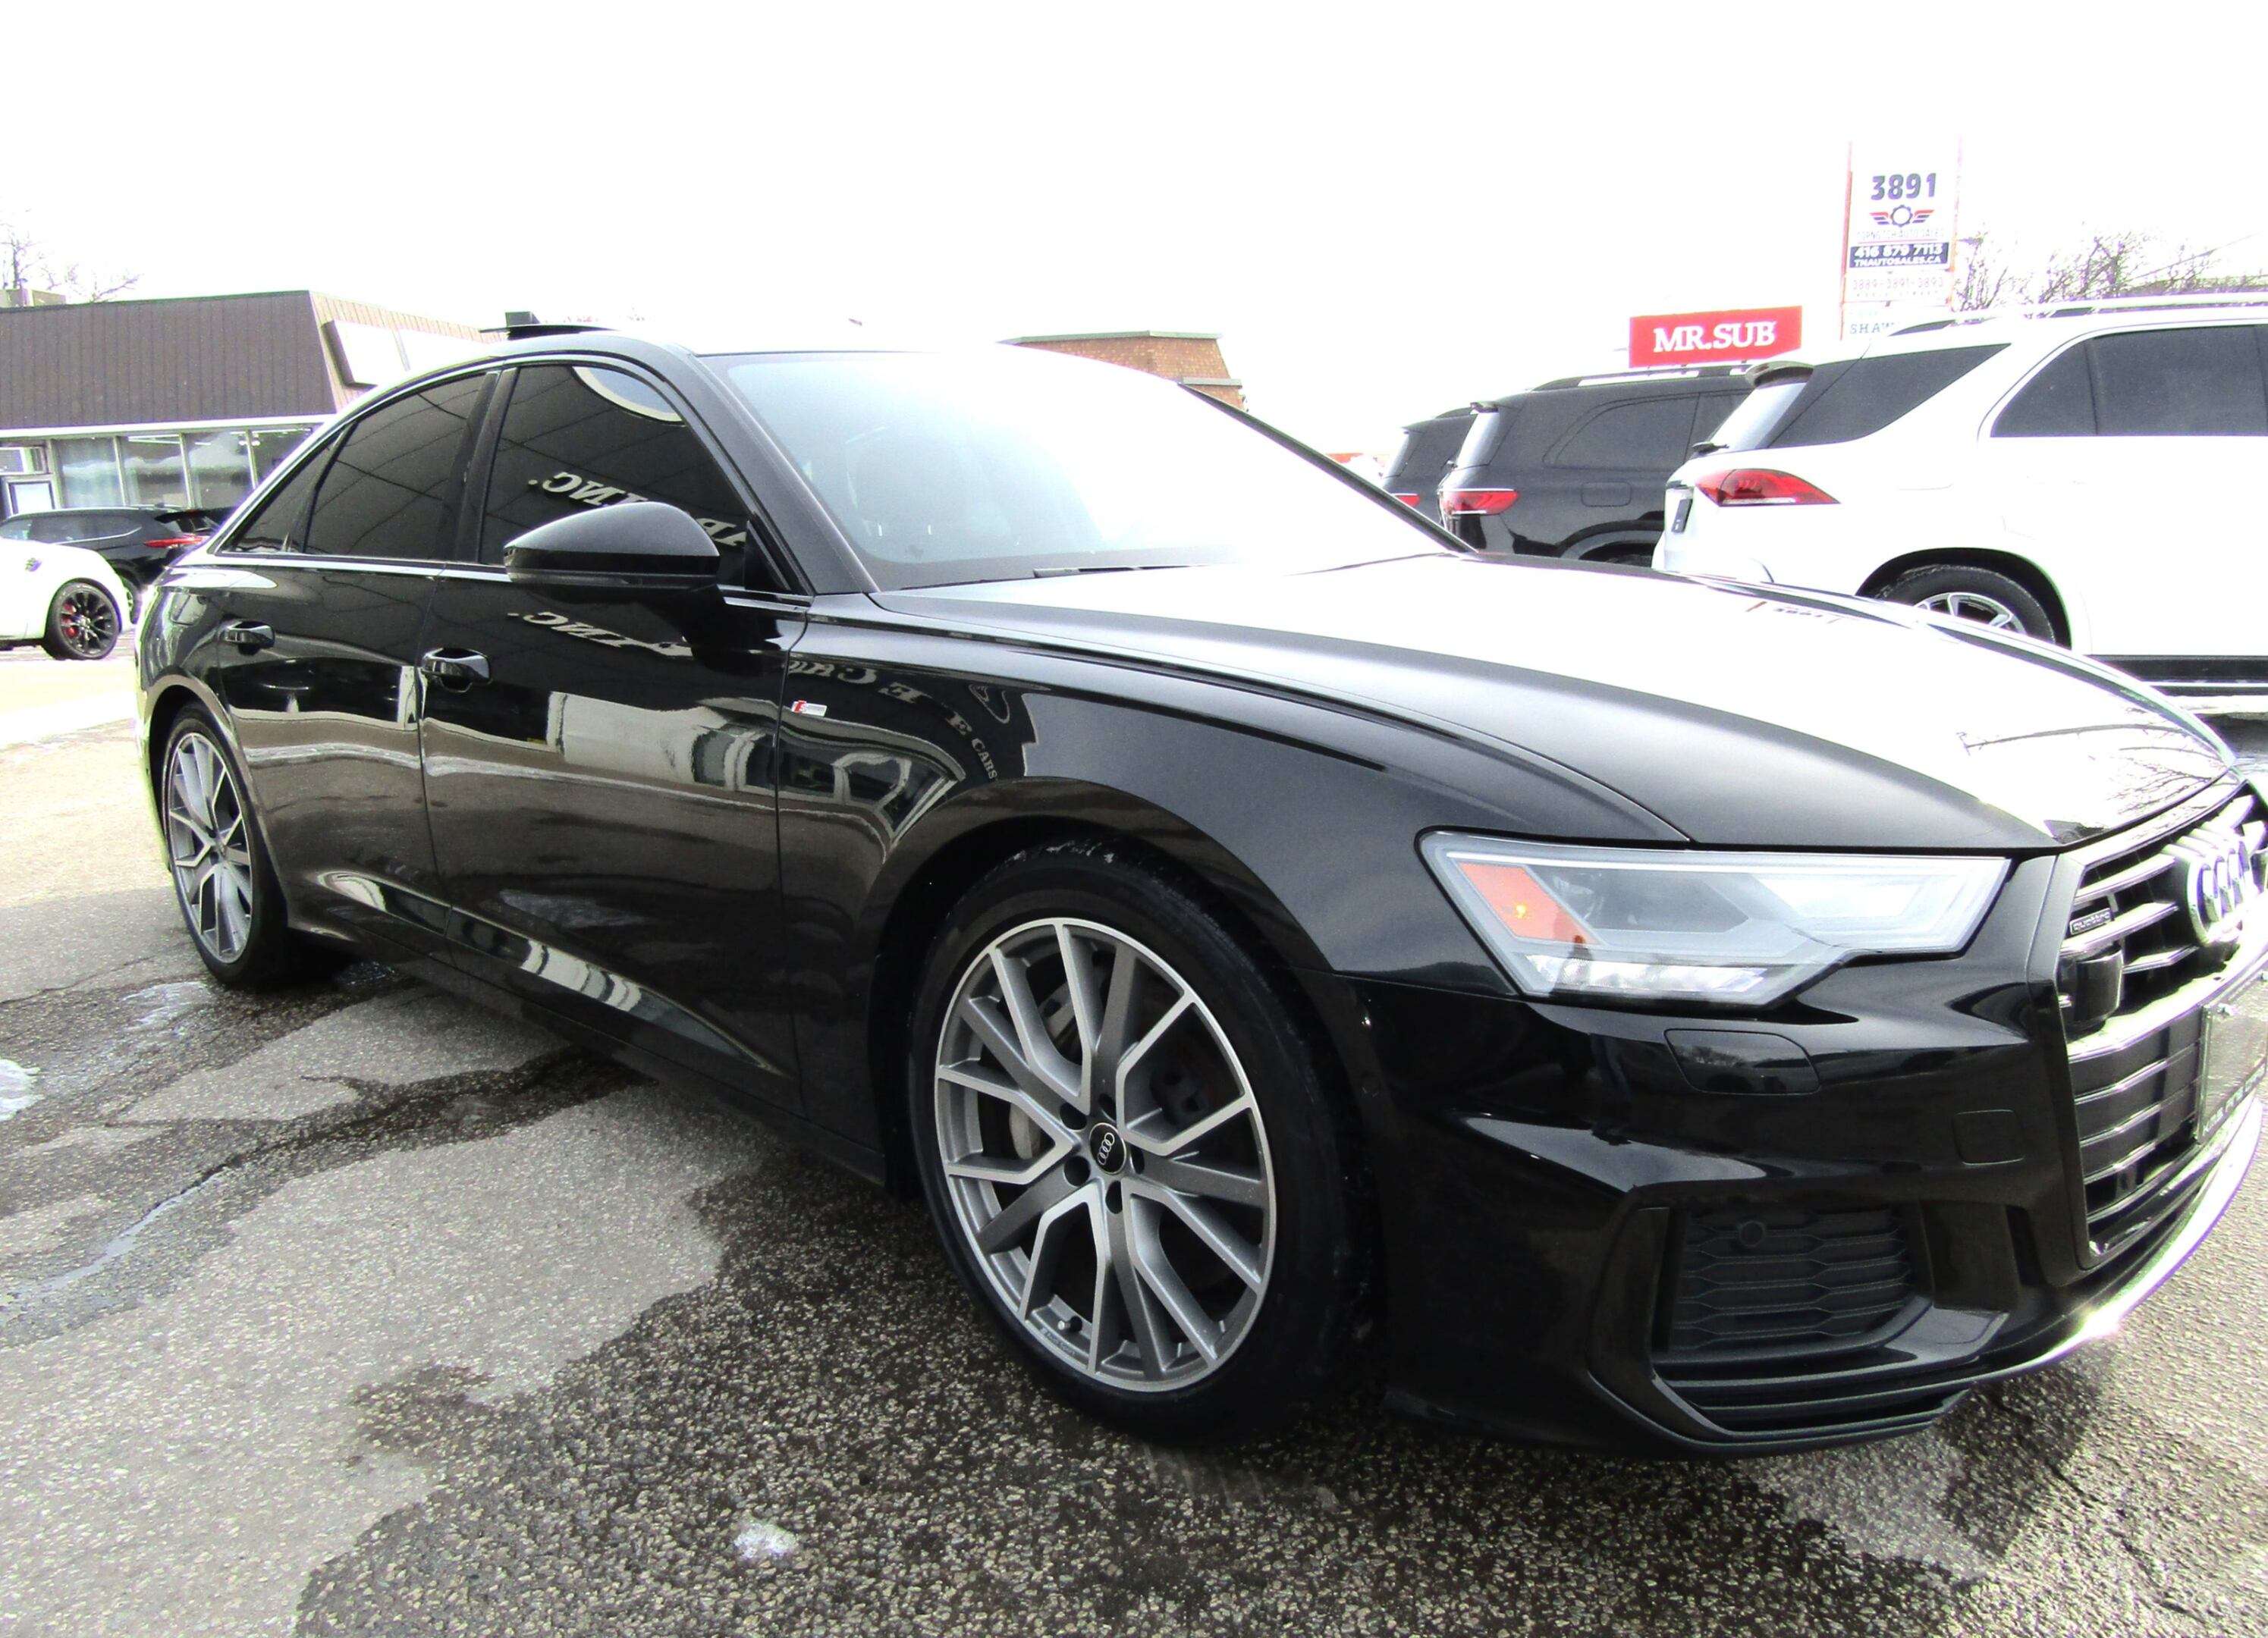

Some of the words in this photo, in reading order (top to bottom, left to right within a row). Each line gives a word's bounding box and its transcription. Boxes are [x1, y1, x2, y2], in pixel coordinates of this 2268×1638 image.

[1871, 173, 1937, 200] 3891
[1855, 246, 1880, 259] 416
[1912, 243, 1943, 256] 7113
[1653, 321, 1777, 353] MR.SUB
